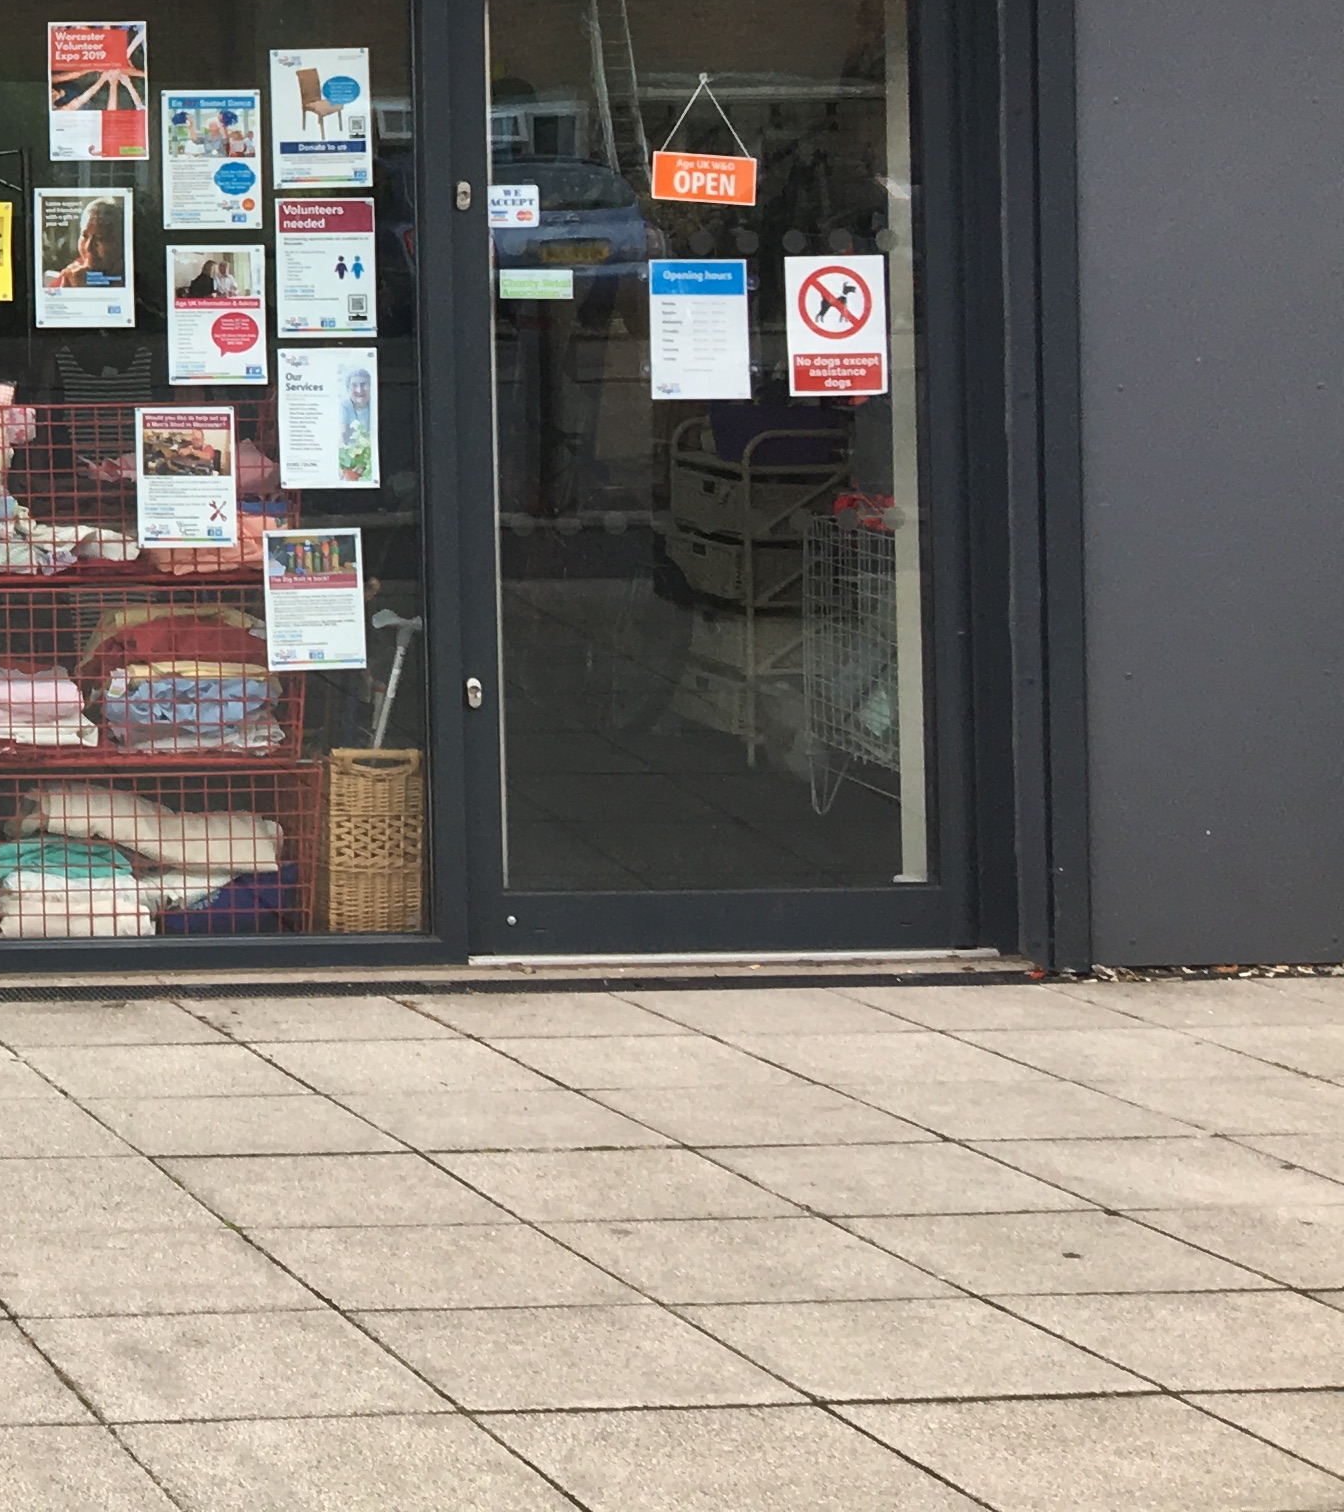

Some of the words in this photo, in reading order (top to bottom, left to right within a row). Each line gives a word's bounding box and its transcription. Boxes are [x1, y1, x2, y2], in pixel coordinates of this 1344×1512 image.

[55, 31, 105, 41] Worcester
[55, 41, 104, 50] Volunteer
[55, 51, 80, 62] Expo
[82, 51, 107, 60] 2019
[298, 143, 326, 152] Donate
[327, 143, 336, 151] to
[676, 158, 694, 170] Age
[696, 160, 710, 169] UK
[673, 170, 736, 197] OPEN
[283, 204, 344, 215] Volunteers
[283, 218, 326, 228] needed
[663, 270, 703, 282] Opening
[704, 270, 733, 281] hours
[796, 356, 812, 366] No
[813, 356, 841, 367] dogs
[843, 356, 880, 367] except
[285, 372, 302, 382] Our
[809, 368, 867, 377] assistance
[285, 382, 324, 392] Services
[824, 378, 852, 390] dogs
